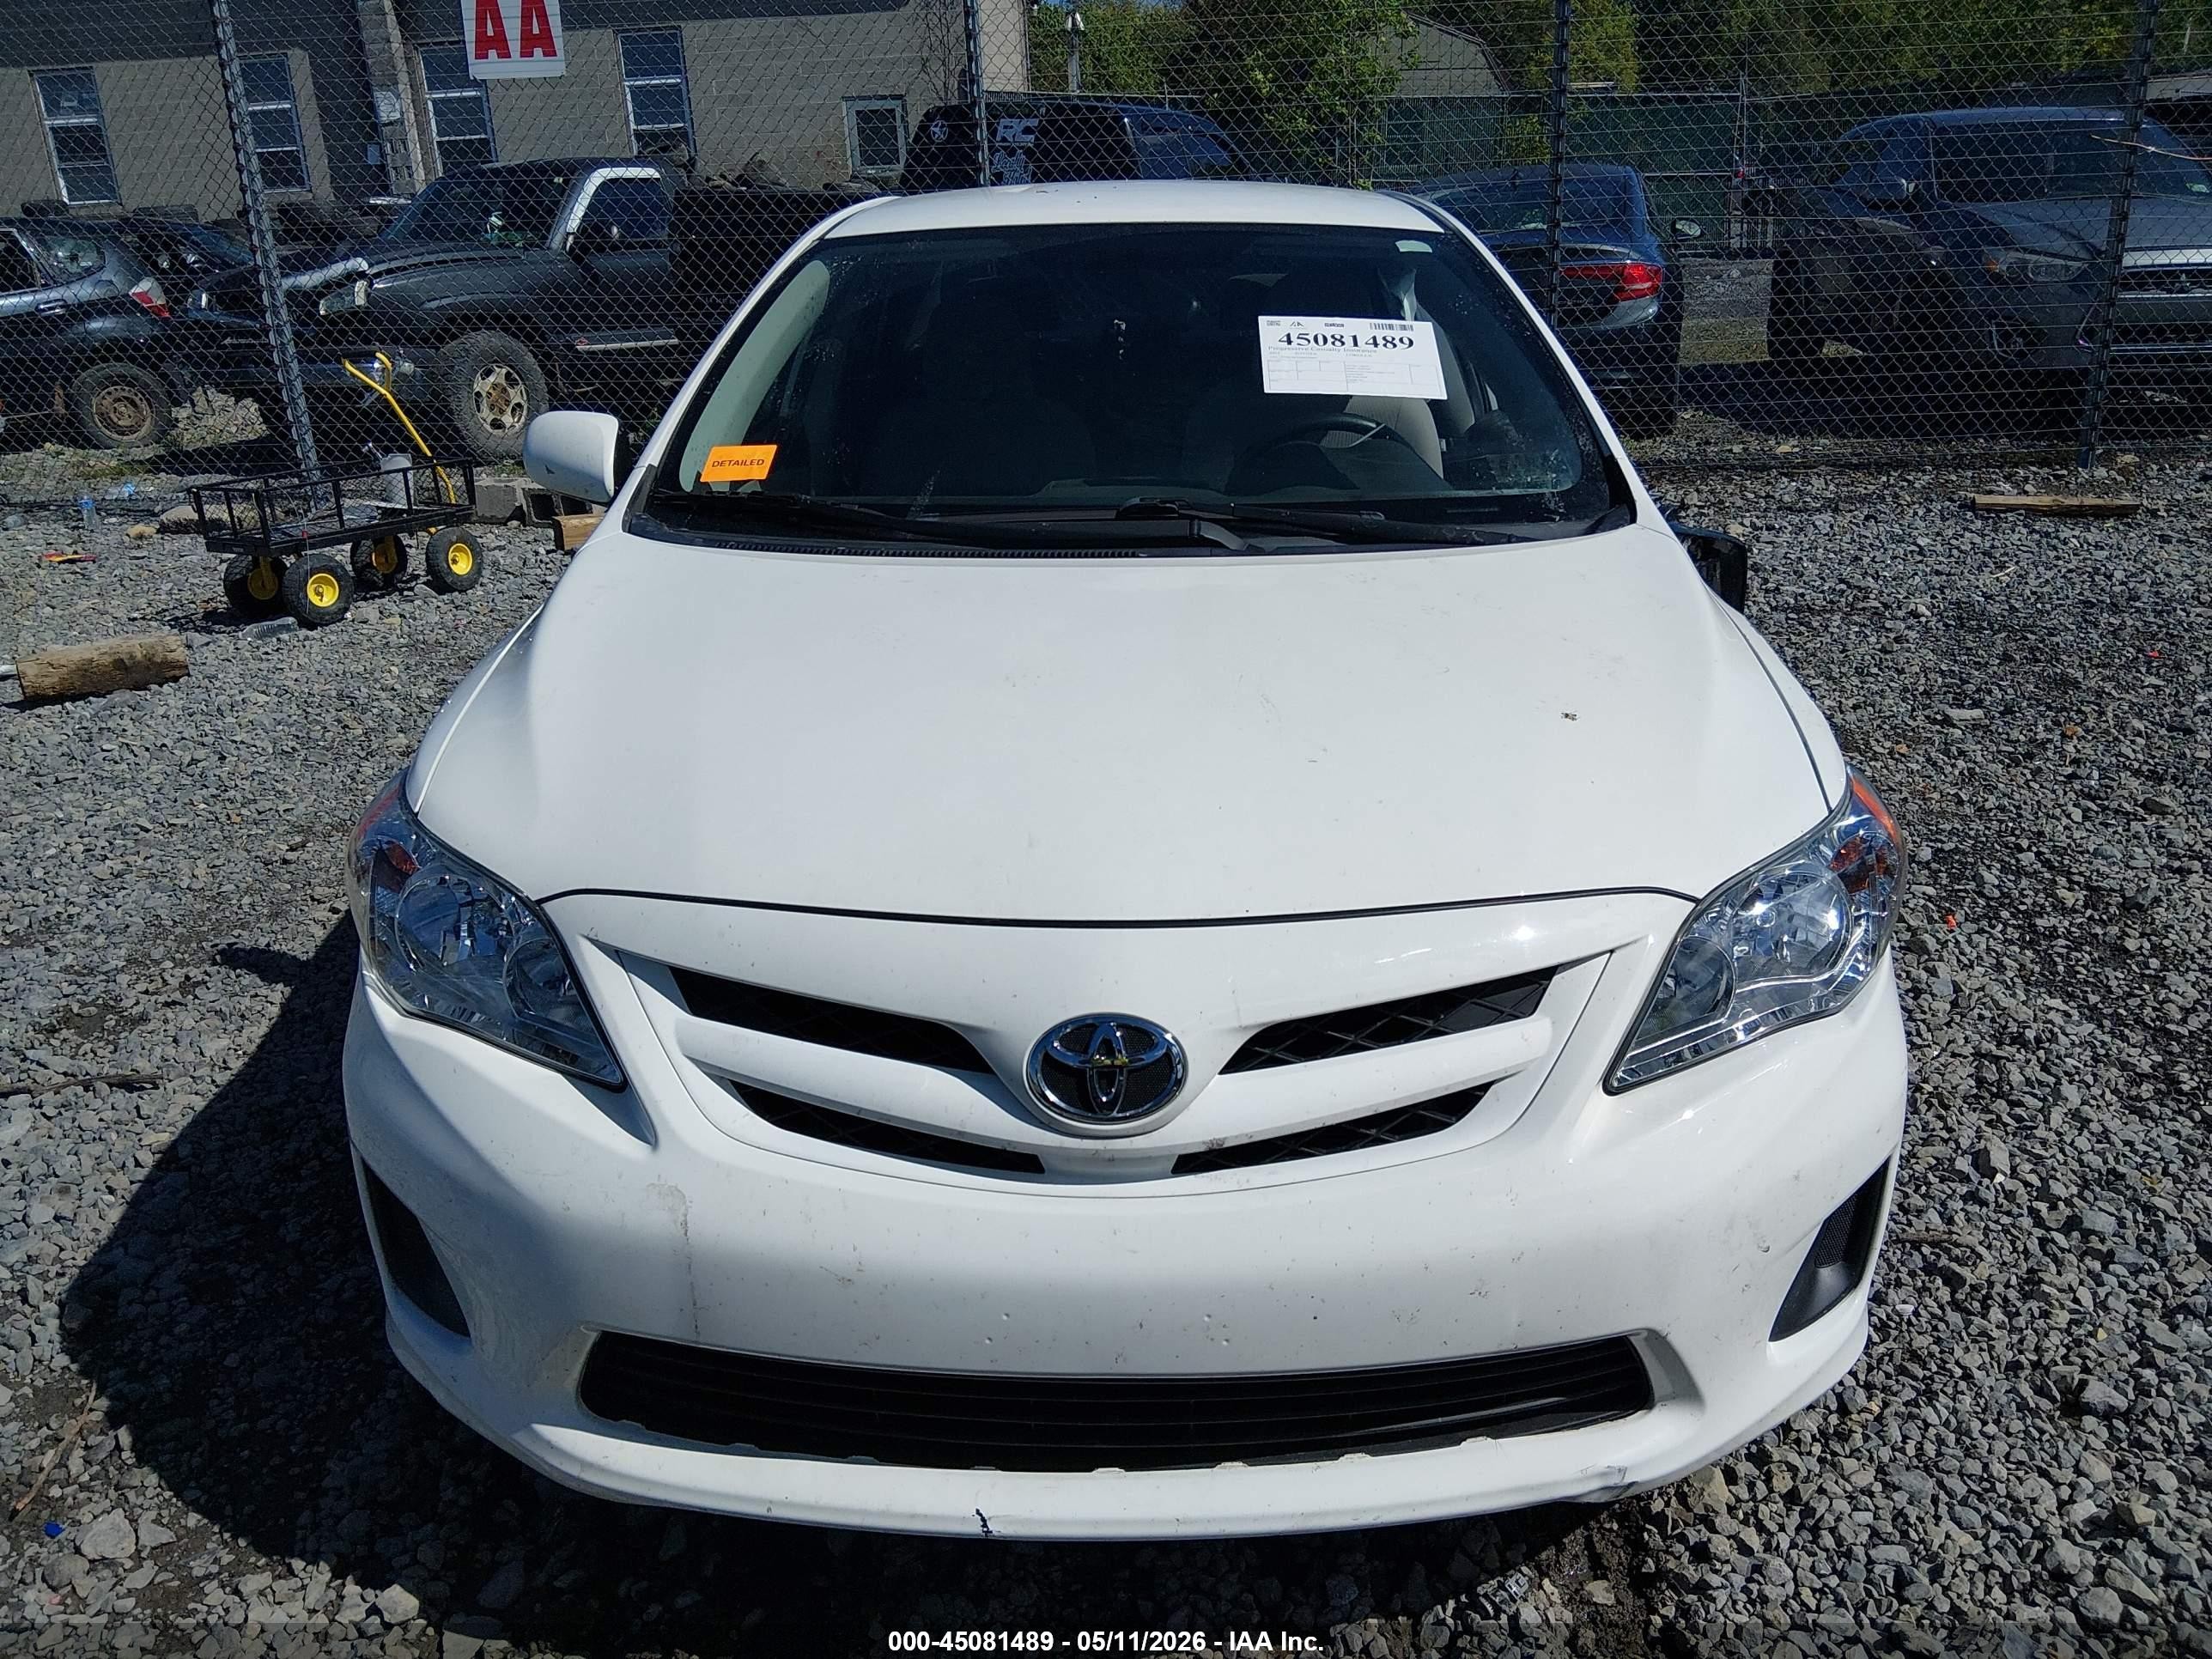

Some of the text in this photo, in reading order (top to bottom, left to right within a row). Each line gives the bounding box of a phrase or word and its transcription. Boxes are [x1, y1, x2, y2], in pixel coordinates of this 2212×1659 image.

[475, 0, 557, 59] AA
[996, 118, 1039, 143] RC
[1278, 331, 1414, 350] 45081489
[712, 459, 765, 468] DETAILED
